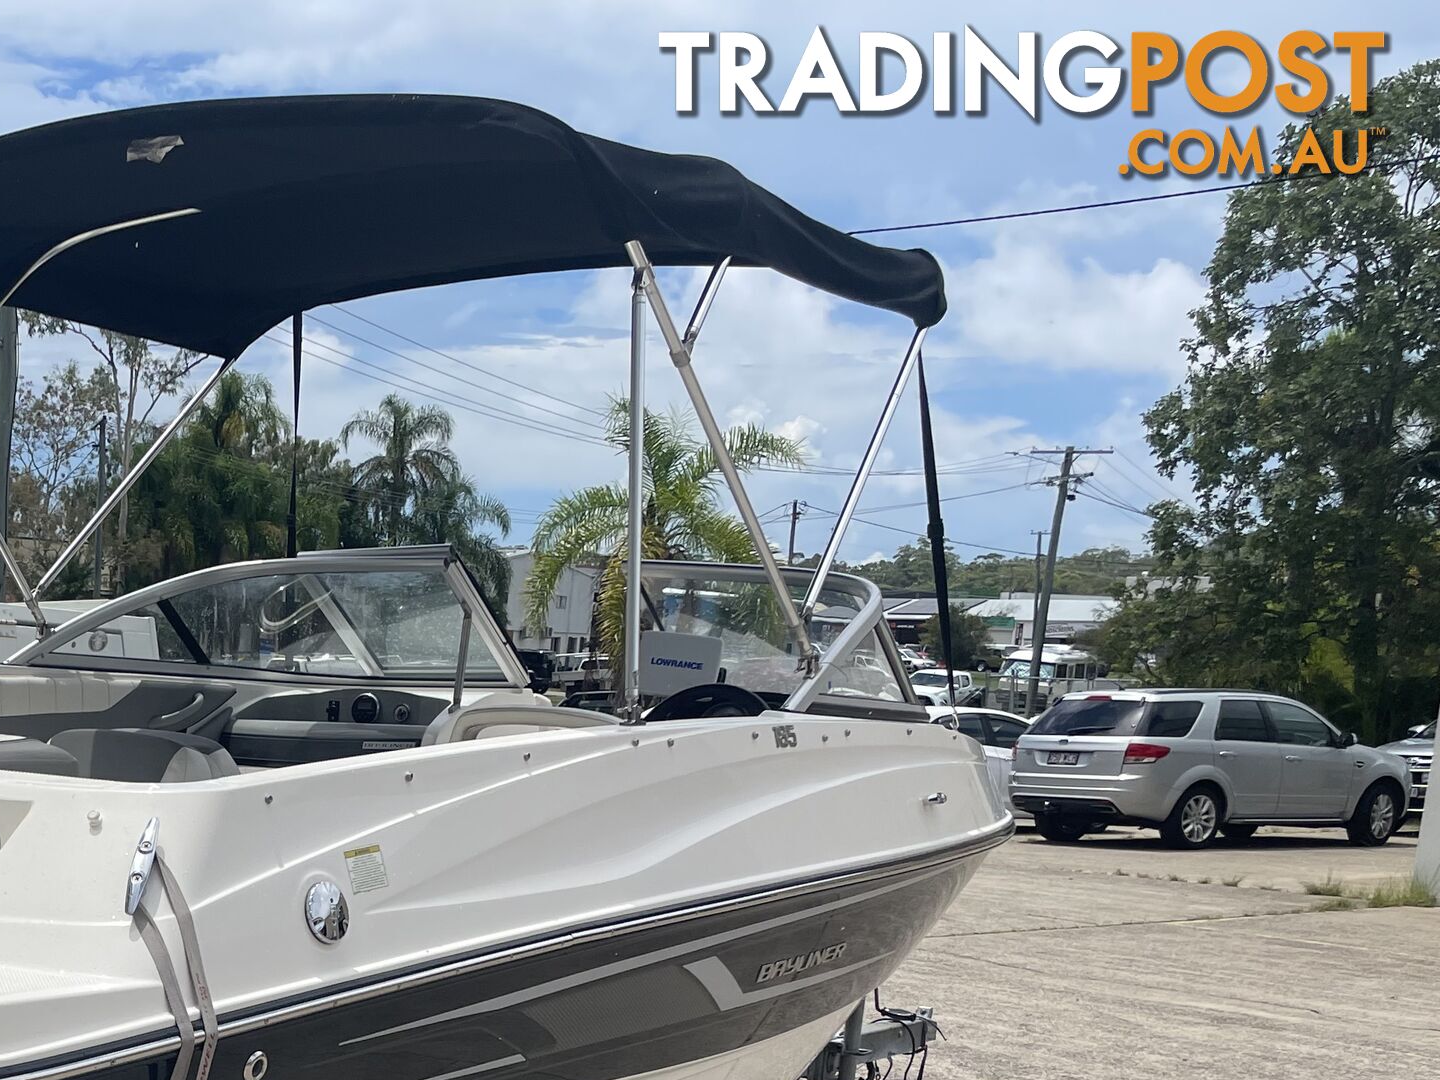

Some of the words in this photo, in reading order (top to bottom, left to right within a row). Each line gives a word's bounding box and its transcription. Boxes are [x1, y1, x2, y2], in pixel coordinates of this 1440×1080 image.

[650, 657, 704, 671] LOWRANCE
[772, 725, 797, 748] 185
[756, 942, 847, 983] BAYLINER
